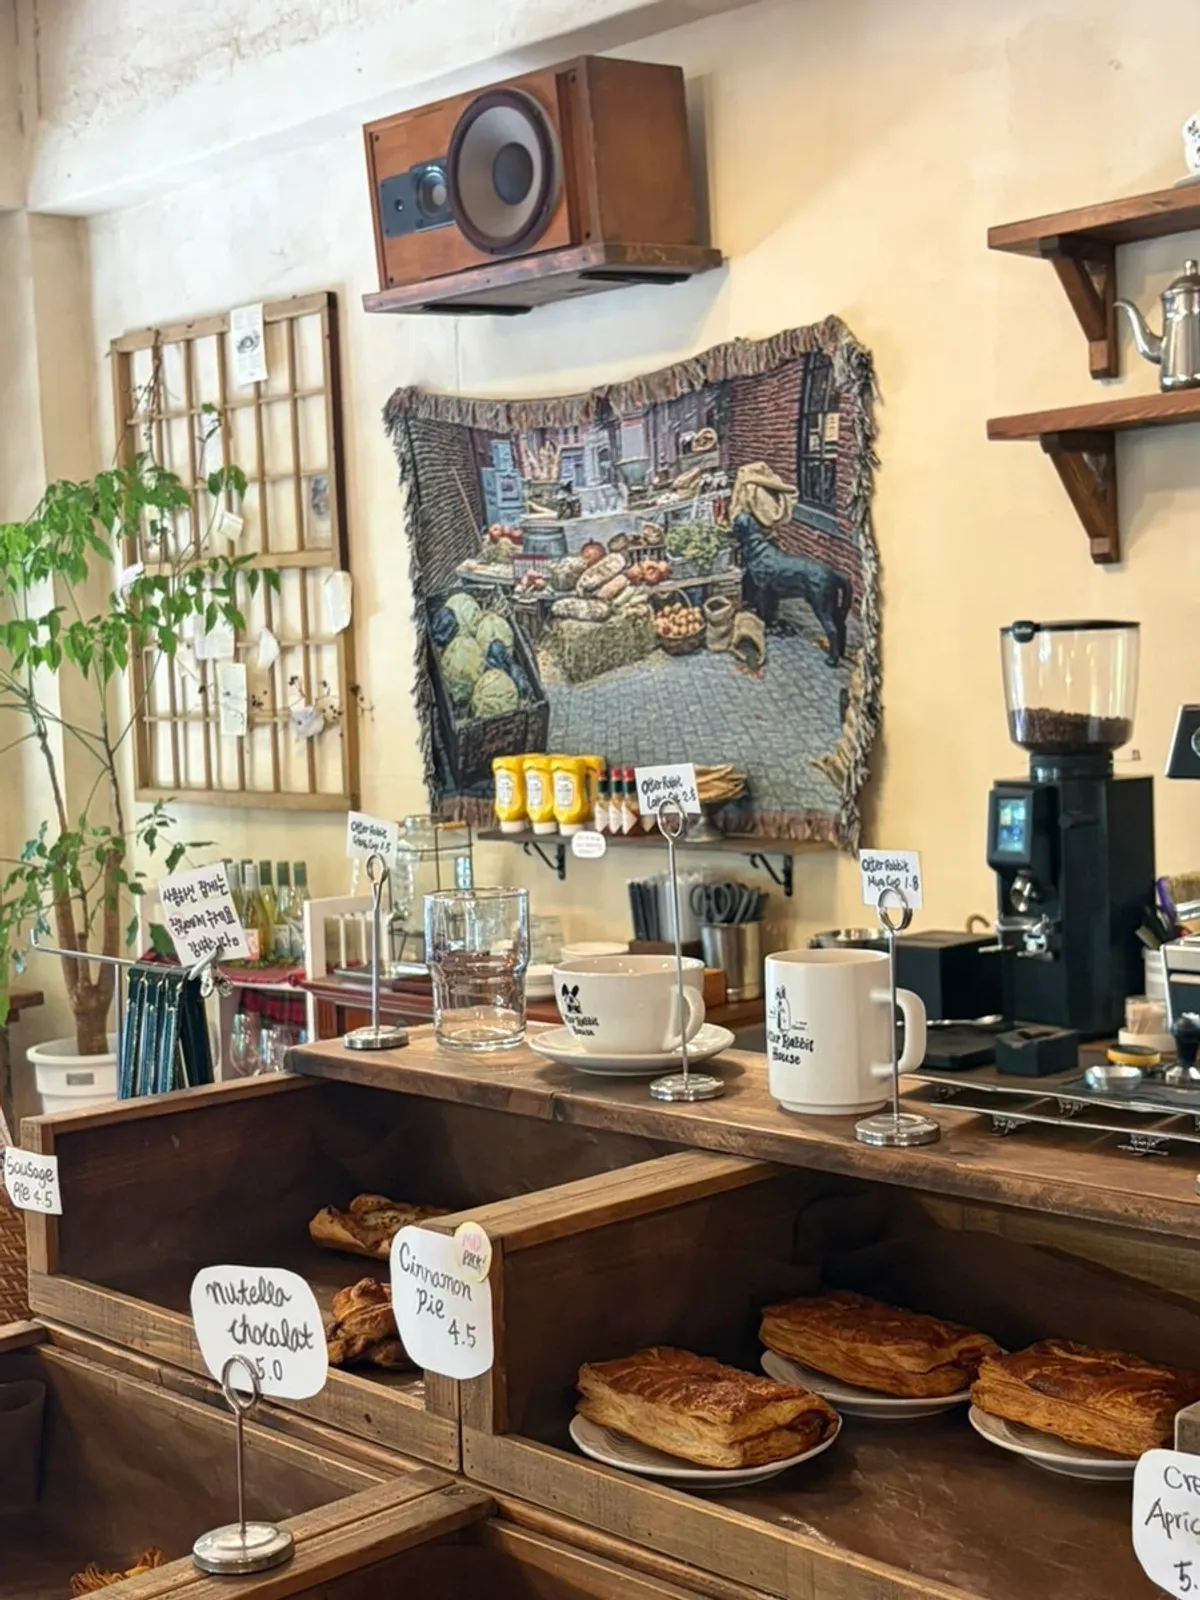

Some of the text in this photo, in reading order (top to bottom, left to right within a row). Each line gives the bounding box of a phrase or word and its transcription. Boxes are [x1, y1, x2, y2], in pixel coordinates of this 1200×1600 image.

[782, 1032, 815, 1053] Rabbit
[6, 1155, 55, 1190] Sausage
[398, 1241, 473, 1302] Cinnamon
[447, 1317, 477, 1349] 4.5
[255, 1356, 283, 1381] 5.0
